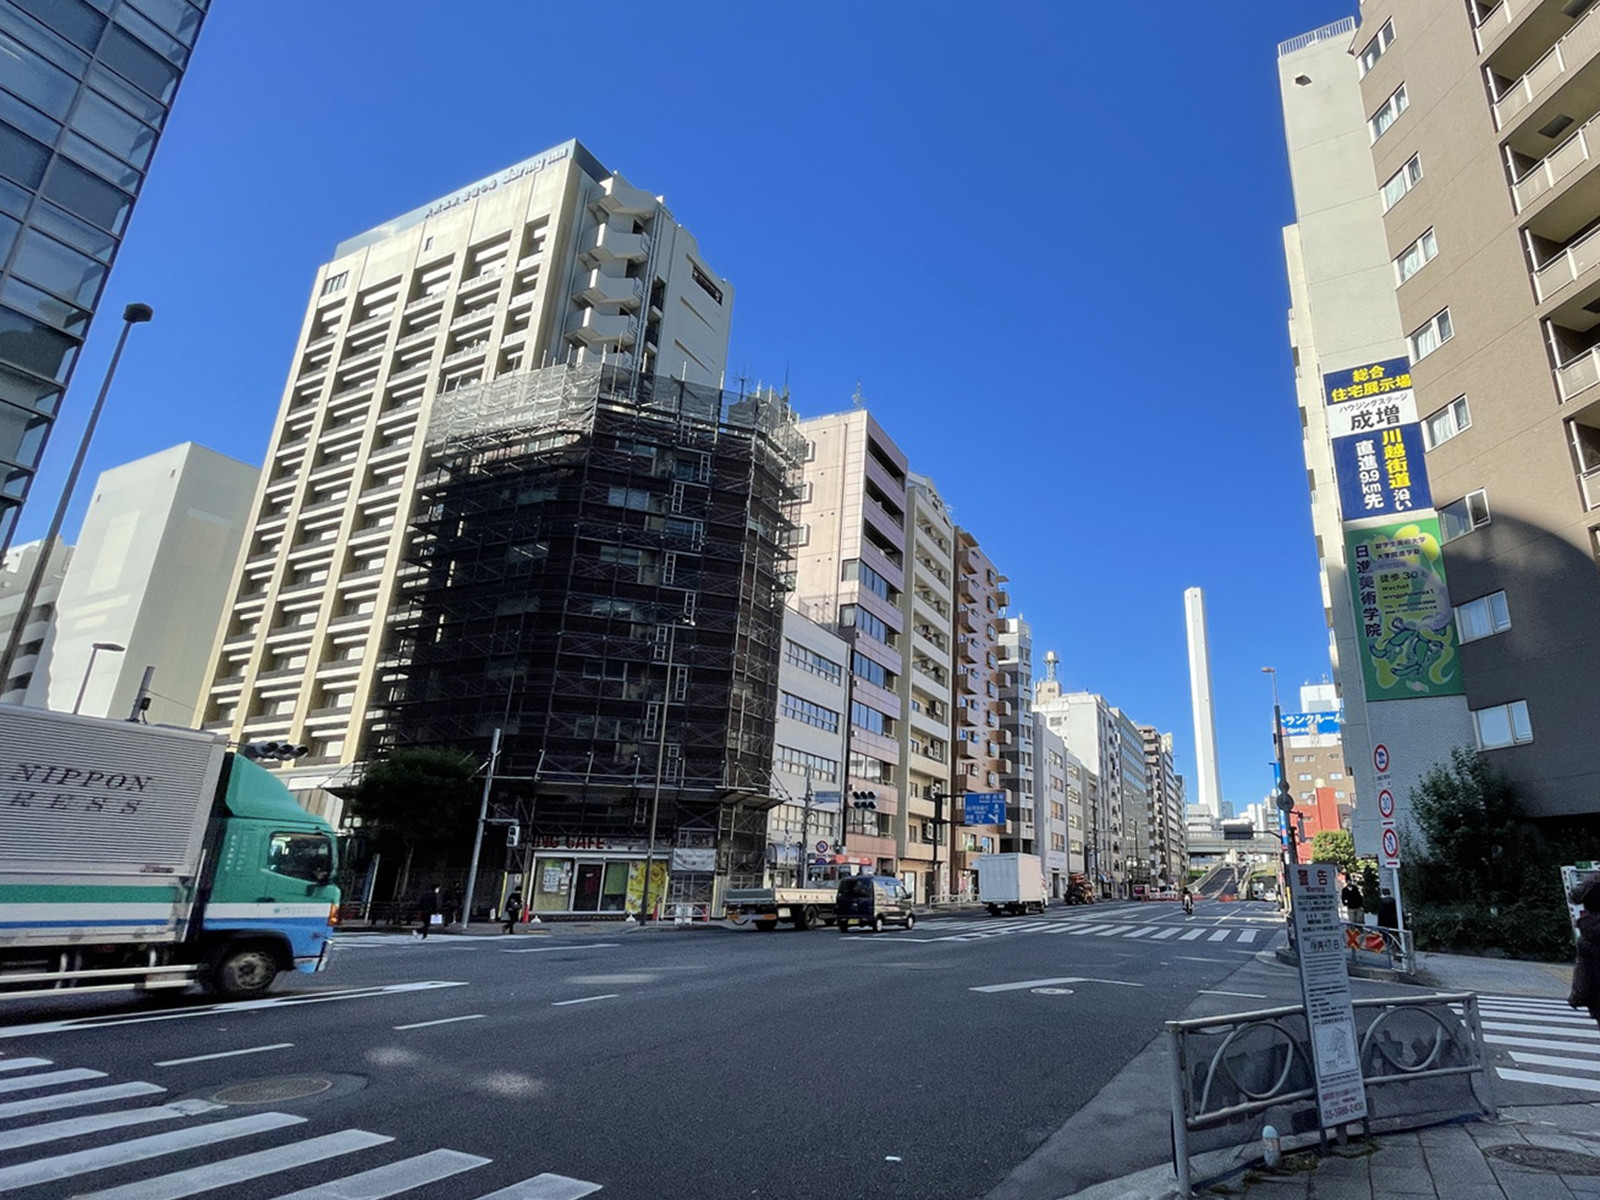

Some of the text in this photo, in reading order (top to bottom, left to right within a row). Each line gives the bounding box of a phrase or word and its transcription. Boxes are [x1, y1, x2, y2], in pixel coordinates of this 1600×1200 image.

[1352, 365, 1385, 382] 総合
[1331, 374, 1411, 402] 住宅展示場
[1339, 393, 1408, 413] ハウジングステージ
[1350, 405, 1400, 431] 成増
[1355, 545, 1383, 638] 日進美術学院
[8, 763, 153, 793] NIPPON
[565, 835, 604, 849] CAFE
